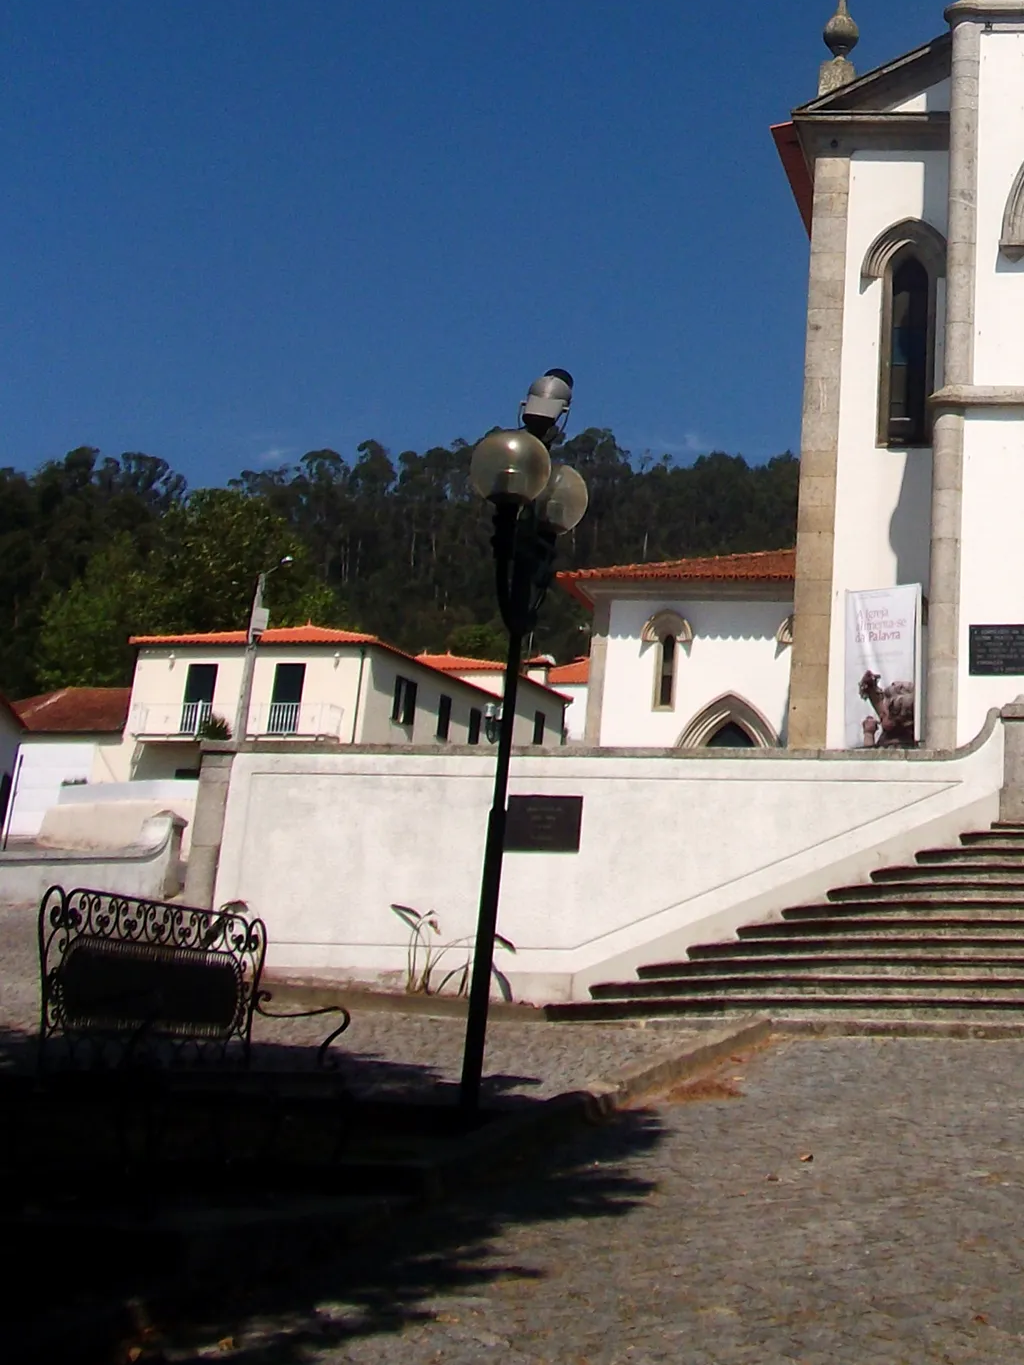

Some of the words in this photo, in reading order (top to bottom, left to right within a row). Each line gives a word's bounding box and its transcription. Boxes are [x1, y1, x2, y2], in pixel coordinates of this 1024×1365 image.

[865, 607, 889, 621] Igreja
[855, 617, 907, 632] alimenta-se
[868, 630, 901, 643] Palavra
